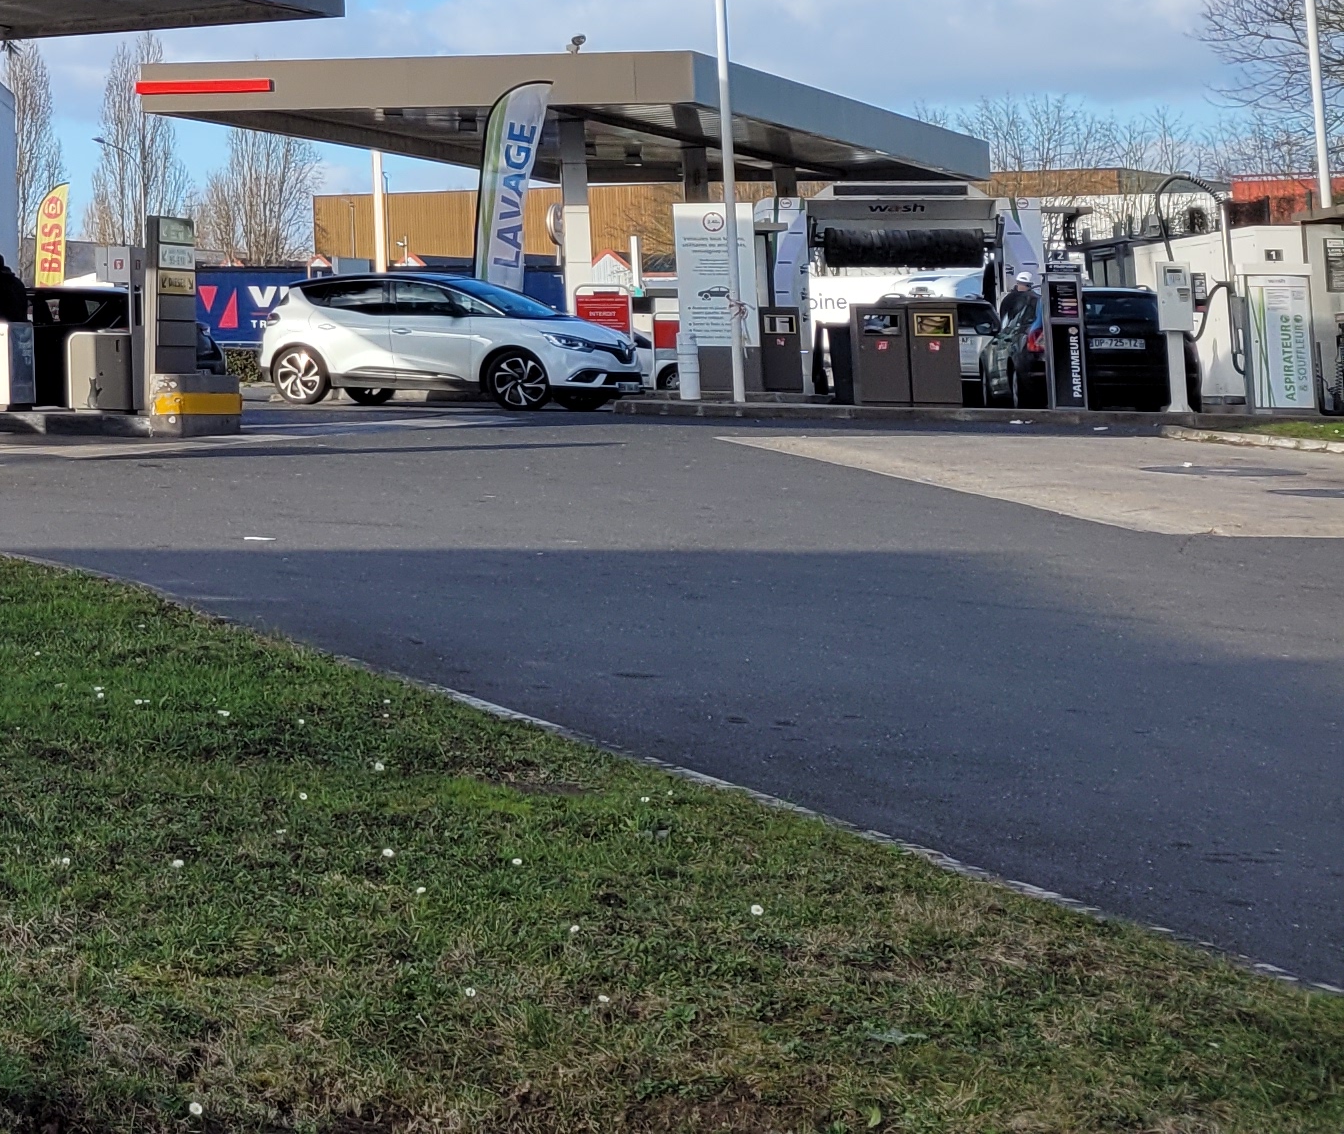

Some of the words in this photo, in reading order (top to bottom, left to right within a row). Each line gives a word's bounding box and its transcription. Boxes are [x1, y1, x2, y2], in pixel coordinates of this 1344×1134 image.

[493, 121, 537, 268] LAVAGE
[40, 223, 62, 273] BAS
[1057, 251, 1064, 260] 2
[1270, 251, 1277, 260] 1
[1068, 335, 1083, 398] PARFUMEUR
[1280, 321, 1297, 401] ASPIRATEUR
[1294, 324, 1308, 383] SOUFFLEUR
